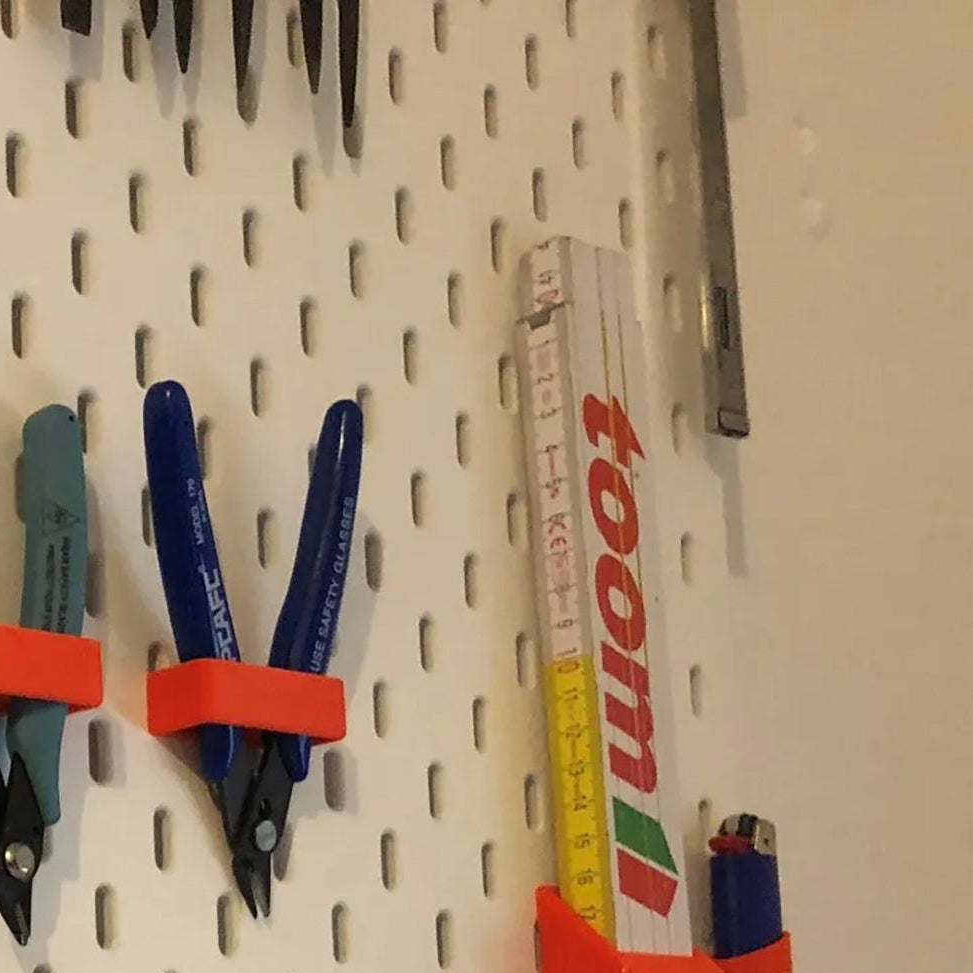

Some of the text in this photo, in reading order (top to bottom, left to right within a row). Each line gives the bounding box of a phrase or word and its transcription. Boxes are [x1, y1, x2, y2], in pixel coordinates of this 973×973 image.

[310, 496, 354, 672] USE SAFETY GLASSES
[583, 393, 657, 794] toom
[574, 832, 590, 849] 15
[577, 868, 594, 885] 16
